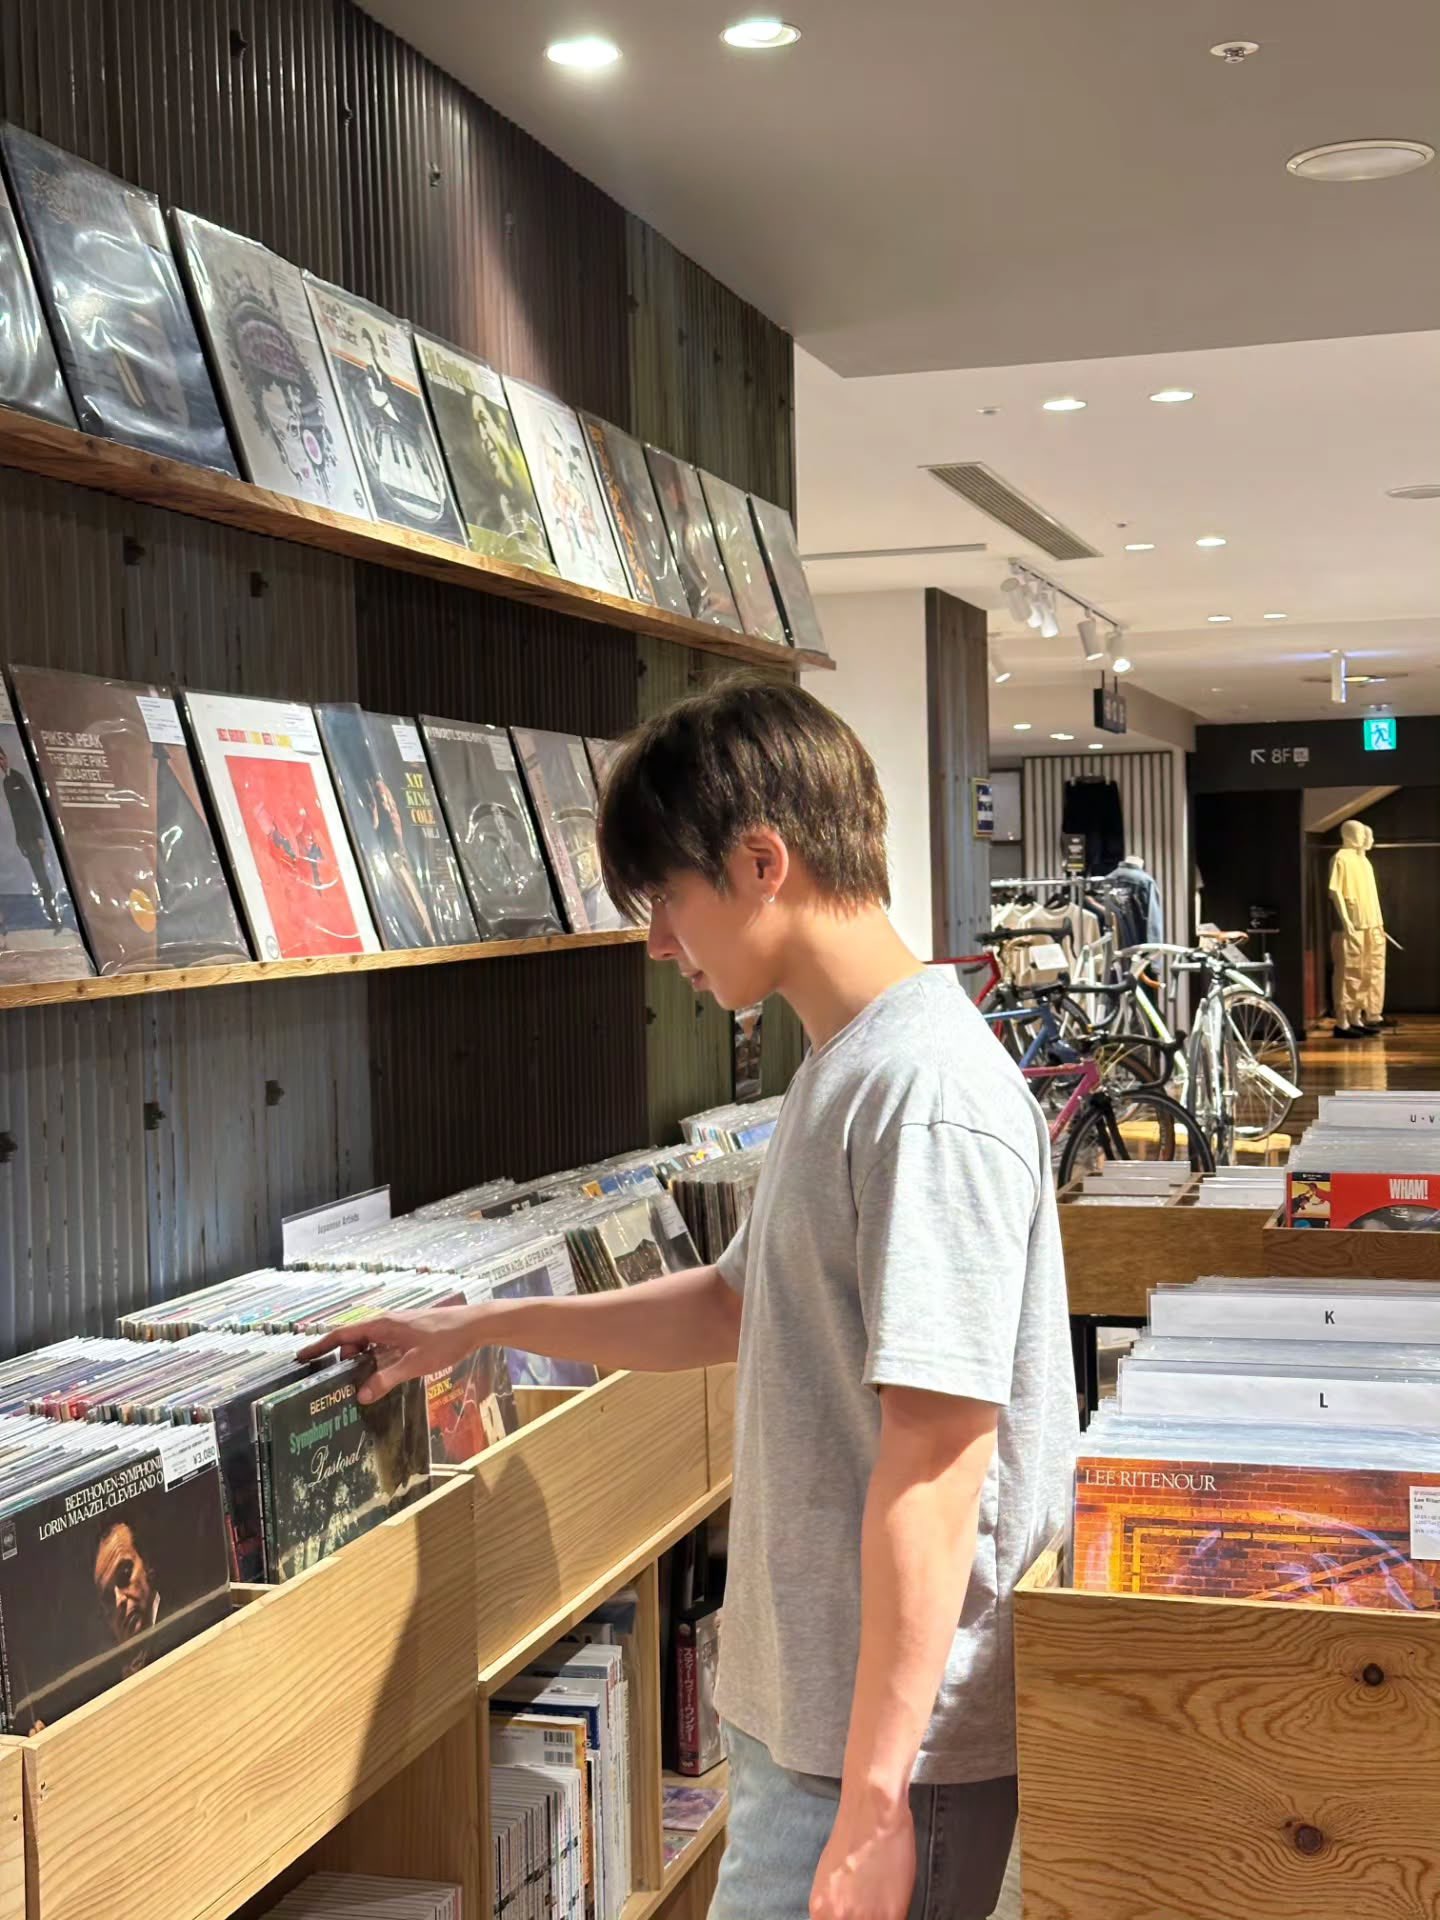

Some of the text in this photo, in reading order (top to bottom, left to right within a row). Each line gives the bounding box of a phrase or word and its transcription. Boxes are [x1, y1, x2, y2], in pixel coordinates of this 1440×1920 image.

[75, 733, 103, 748] PEAK
[1271, 748, 1291, 764] 8F
[405, 772, 424, 788] NAT
[406, 791, 430, 806] KING
[411, 807, 436, 825] COLE
[1389, 1178, 1429, 1200] WHAM!
[1325, 1310, 1335, 1325] K
[1320, 1392, 1328, 1408] L
[290, 1418, 333, 1456] Symphony
[308, 1430, 366, 1488] Pastoral
[1085, 1469, 1217, 1491] LEE RITENOUR
[39, 1515, 68, 1541] LORIN
